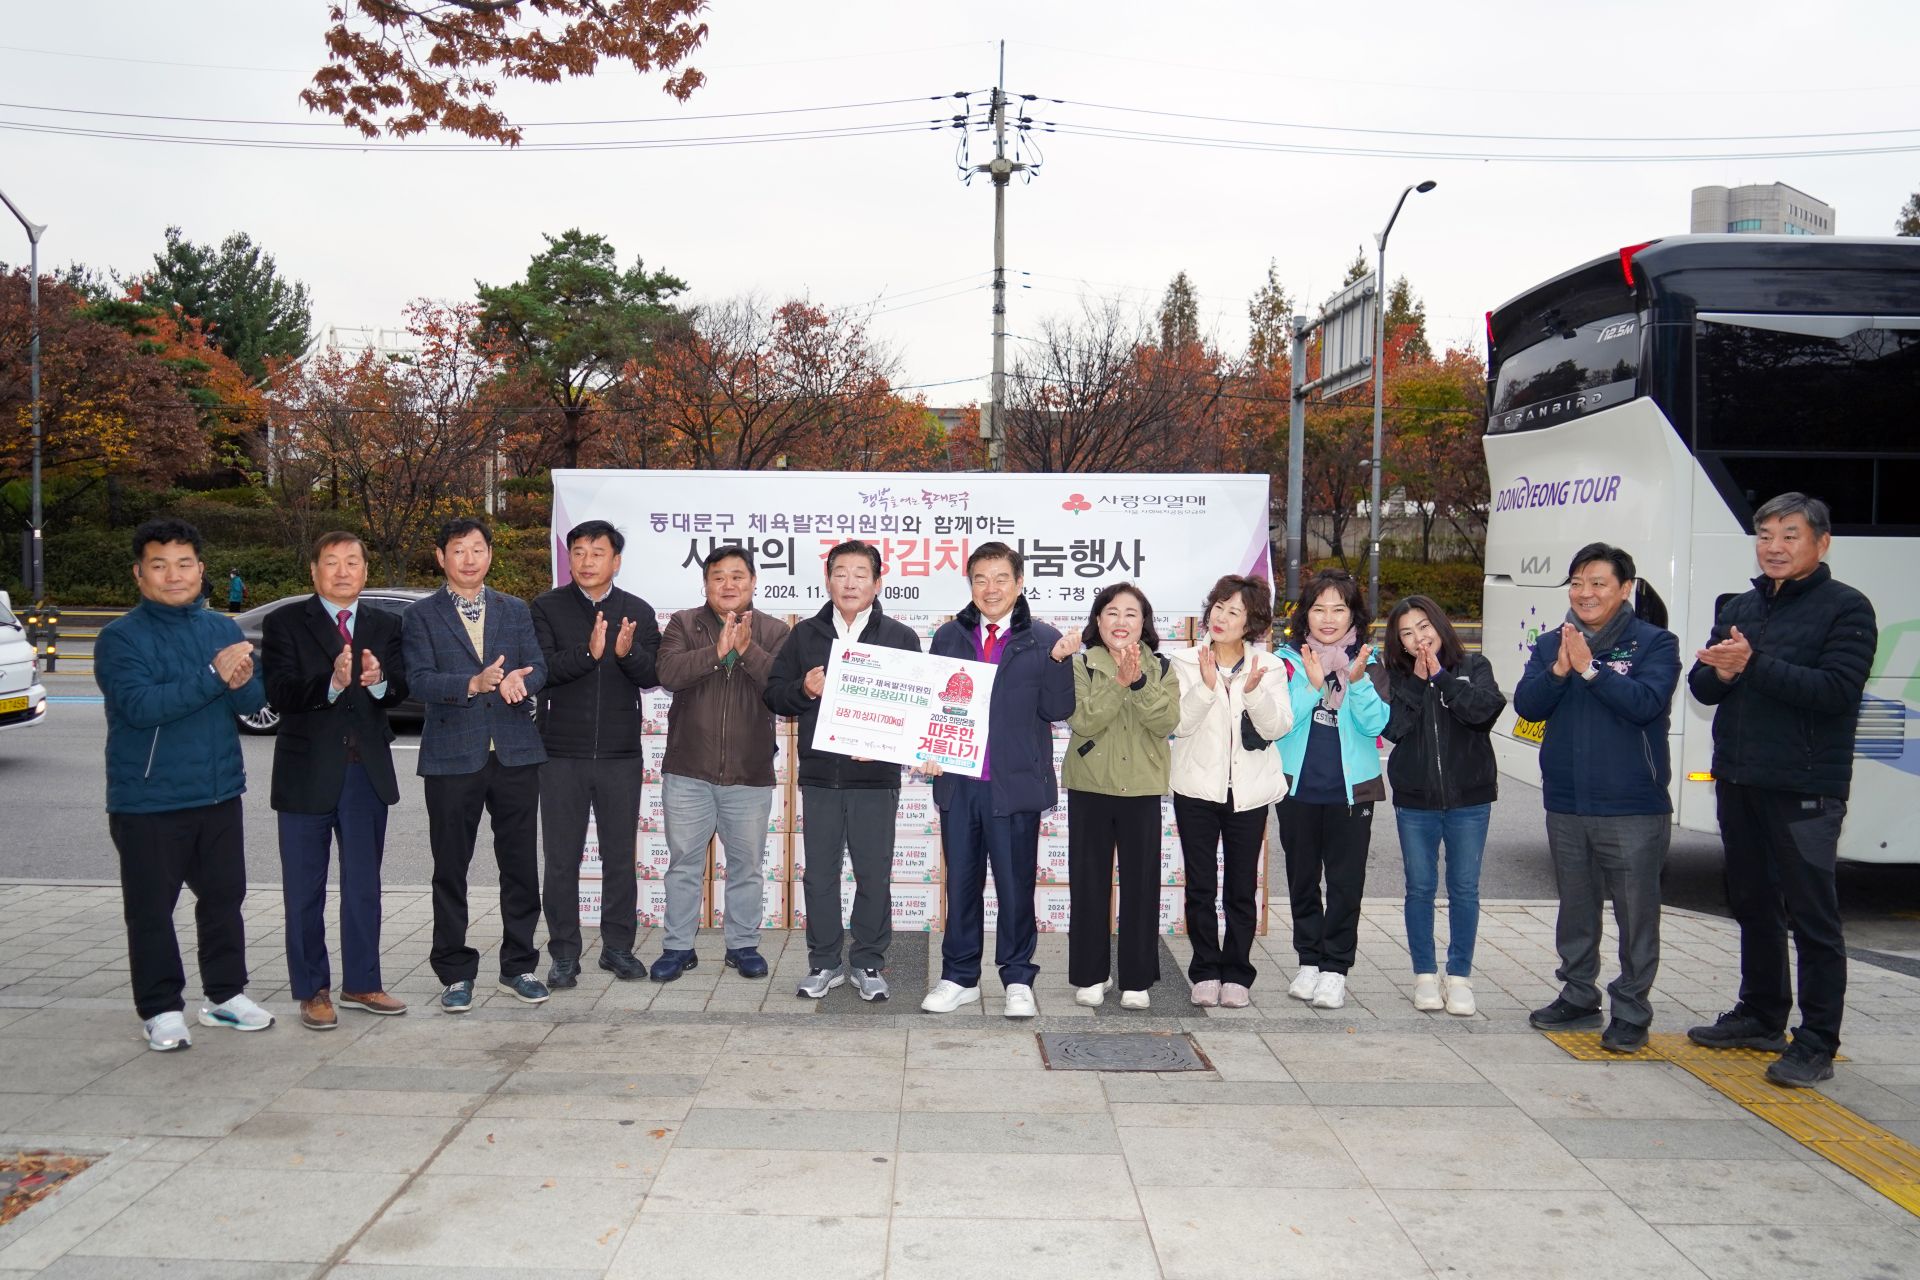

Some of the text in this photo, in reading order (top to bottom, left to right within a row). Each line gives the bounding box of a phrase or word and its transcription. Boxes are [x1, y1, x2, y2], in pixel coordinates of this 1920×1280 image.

[1603, 322, 1636, 341] 12.5M
[1504, 393, 1602, 426] GRANBIRD
[921, 489, 969, 511] 동대문구
[1496, 475, 1621, 512] DONGYEONG TOUR
[1098, 495, 1206, 509] 사랑의열매
[650, 513, 1015, 534] 동대문구 체육발전위원회와 함께하는
[1521, 556, 1551, 574] KIA
[764, 586, 799, 599] 2024.
[806, 586, 824, 599] 11.
[884, 586, 920, 600] 09:00
[1059, 587, 1085, 602] 구청
[842, 673, 932, 695] 동대문구 체육발전위원회
[839, 683, 868, 697] 사랑의
[909, 695, 929, 706] 나눔
[836, 706, 852, 718] 김장
[930, 713, 948, 723] 2025
[928, 721, 975, 743] 따뜻한
[917, 736, 979, 761] 겨울나기
[906, 803, 928, 811] 사랑의
[653, 856, 669, 865] 김장
[905, 851, 927, 859] 사랑의
[905, 900, 927, 908] 사랑의
[905, 909, 924, 917] 나누기
